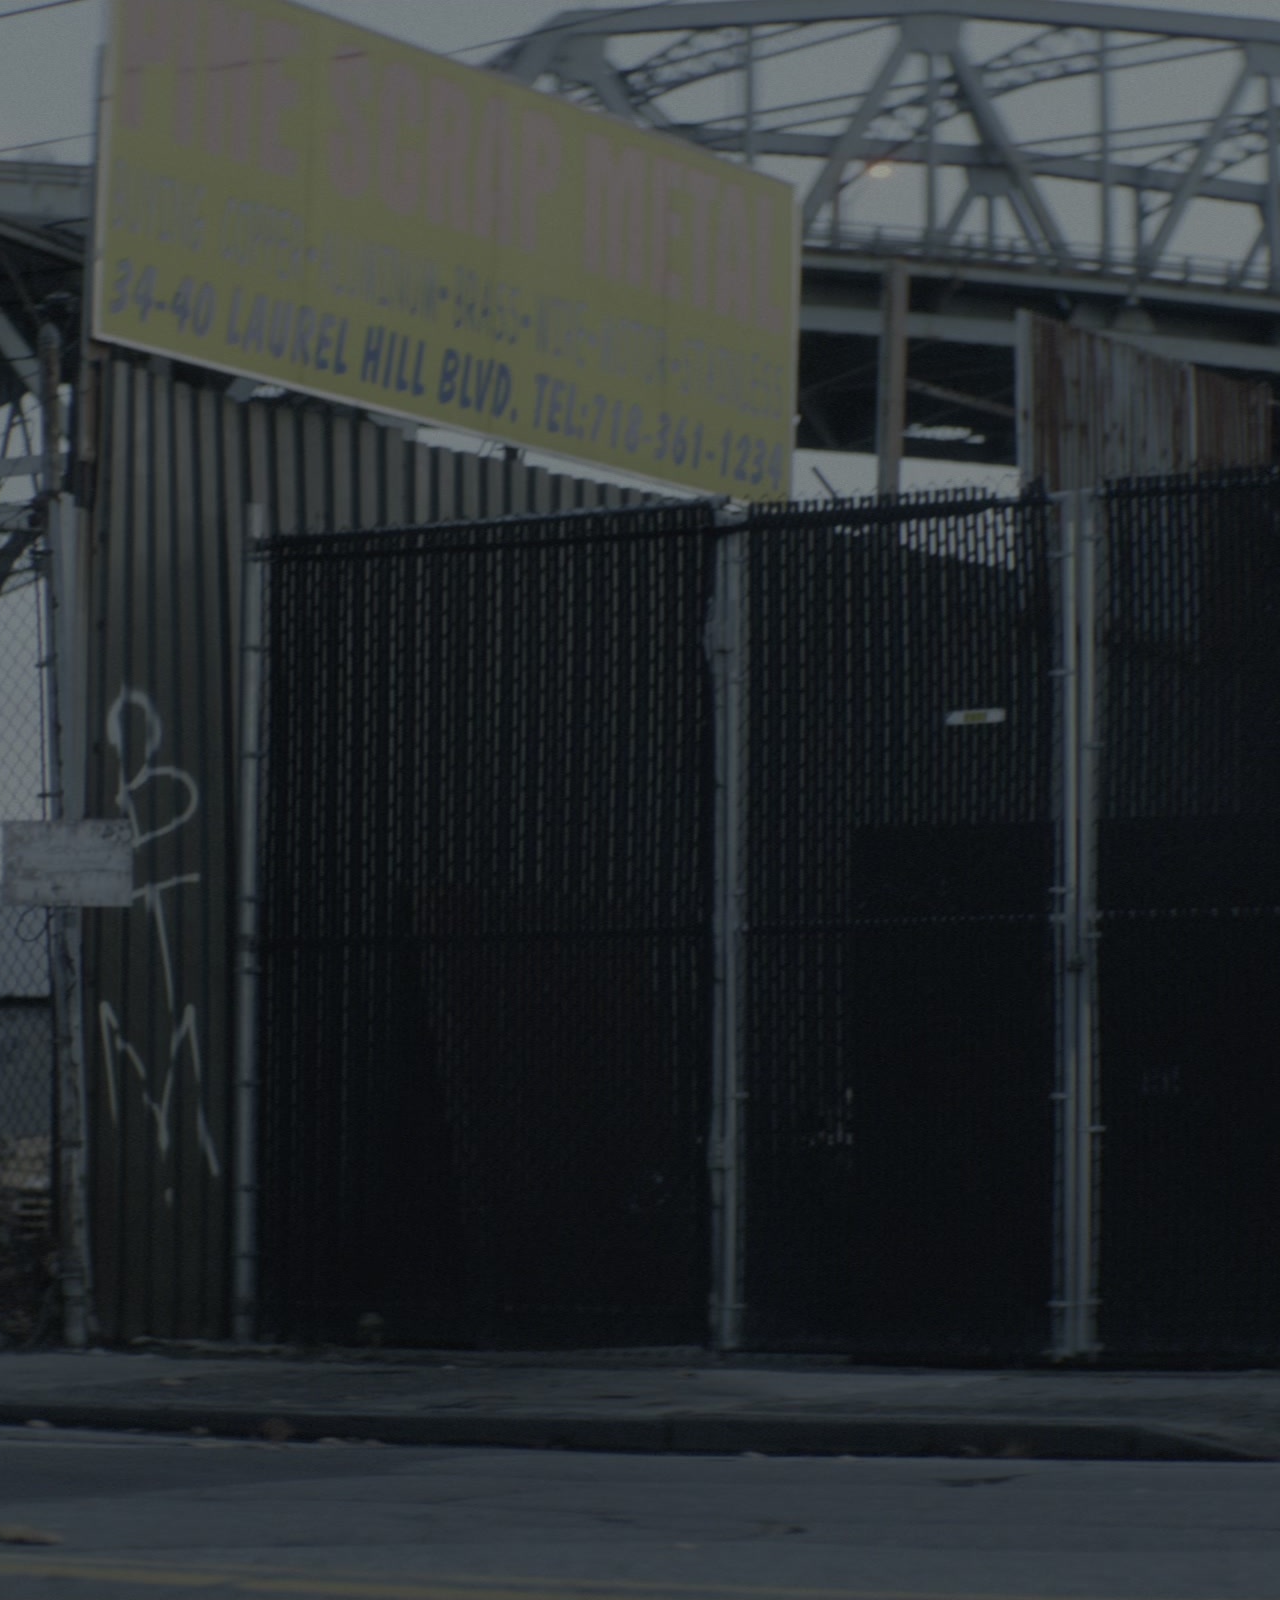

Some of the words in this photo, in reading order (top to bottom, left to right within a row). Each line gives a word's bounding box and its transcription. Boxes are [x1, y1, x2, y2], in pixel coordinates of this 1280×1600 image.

[118, 0, 305, 177] PINE
[327, 41, 562, 252] SCRAP
[582, 133, 785, 334] METAL
[108, 257, 218, 339] 34-40
[226, 284, 351, 377] LAUREL
[359, 323, 428, 398] HILL
[437, 346, 520, 424] BLVD.
